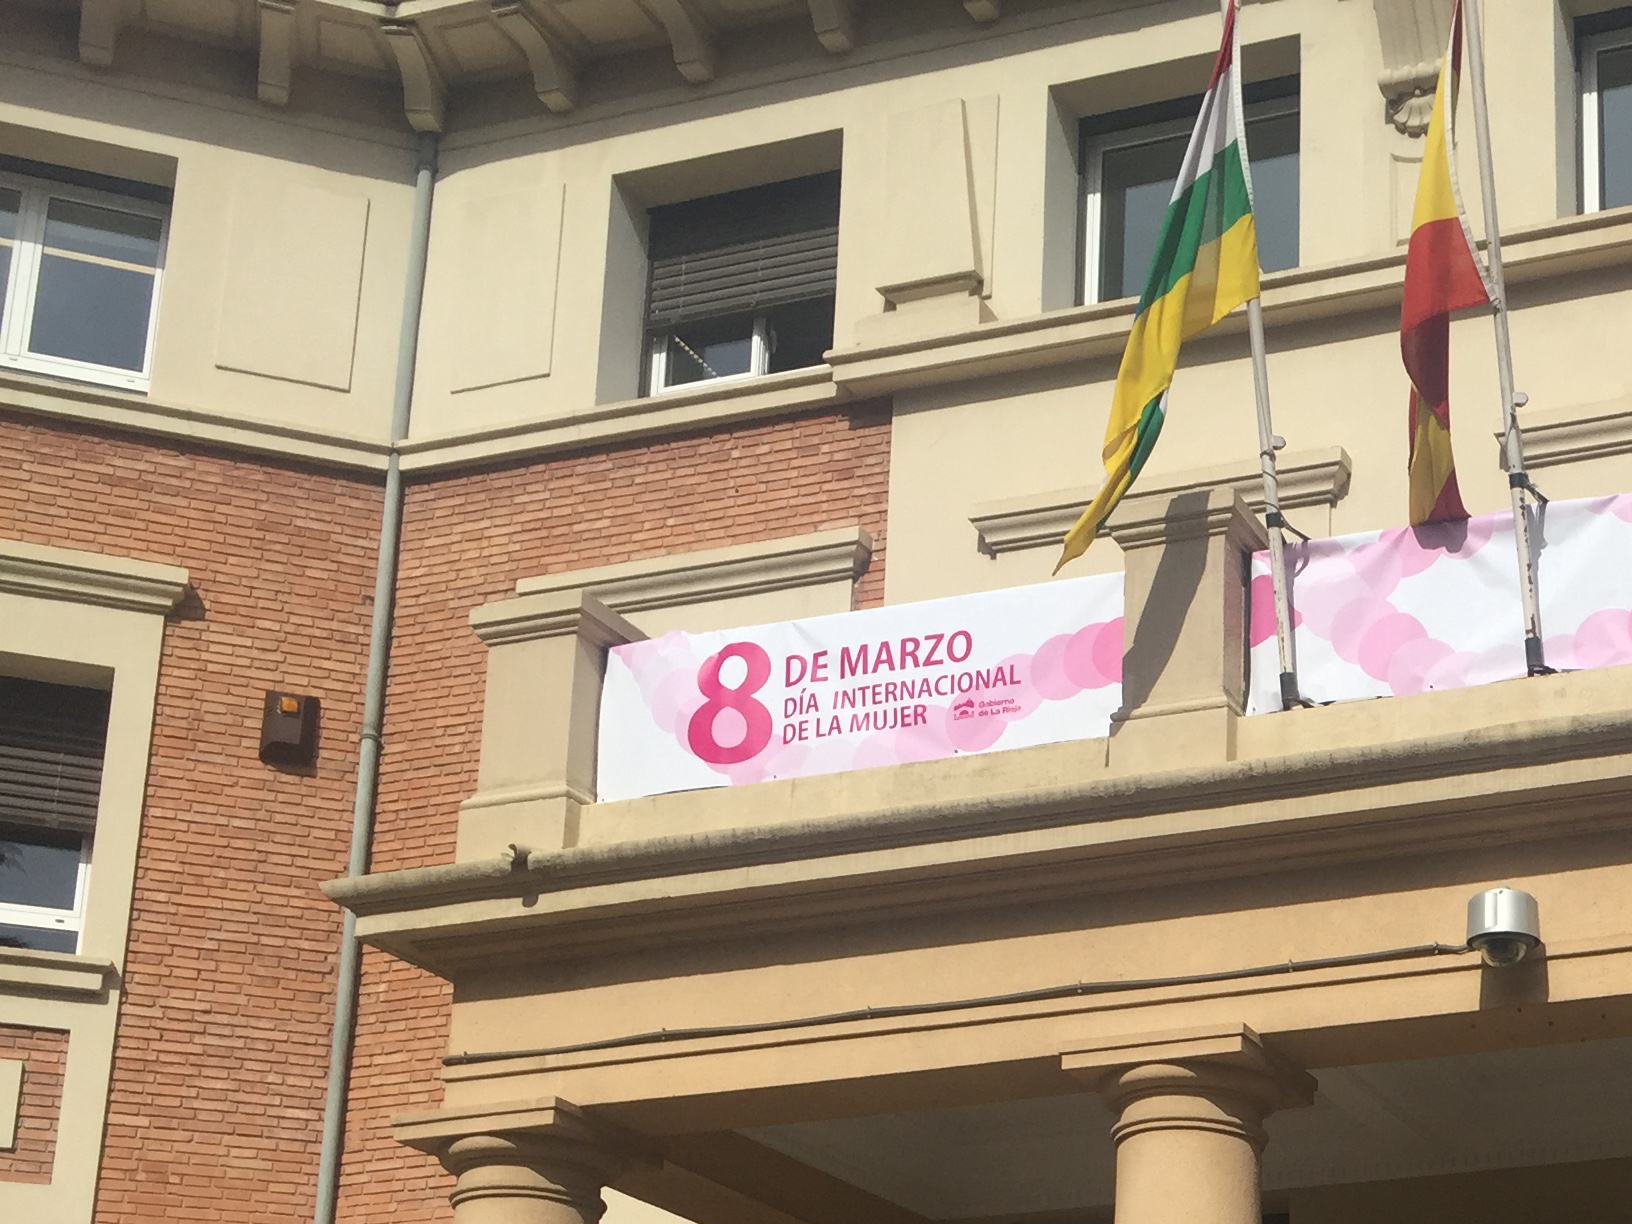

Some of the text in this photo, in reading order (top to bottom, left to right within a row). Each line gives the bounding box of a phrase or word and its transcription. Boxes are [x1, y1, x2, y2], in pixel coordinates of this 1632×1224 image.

[784, 630, 973, 687] DE MARZO
[688, 641, 772, 765] 8
[782, 665, 1022, 719] DÍA INTERNACIONAL
[782, 703, 928, 745] DE LA MUJER
